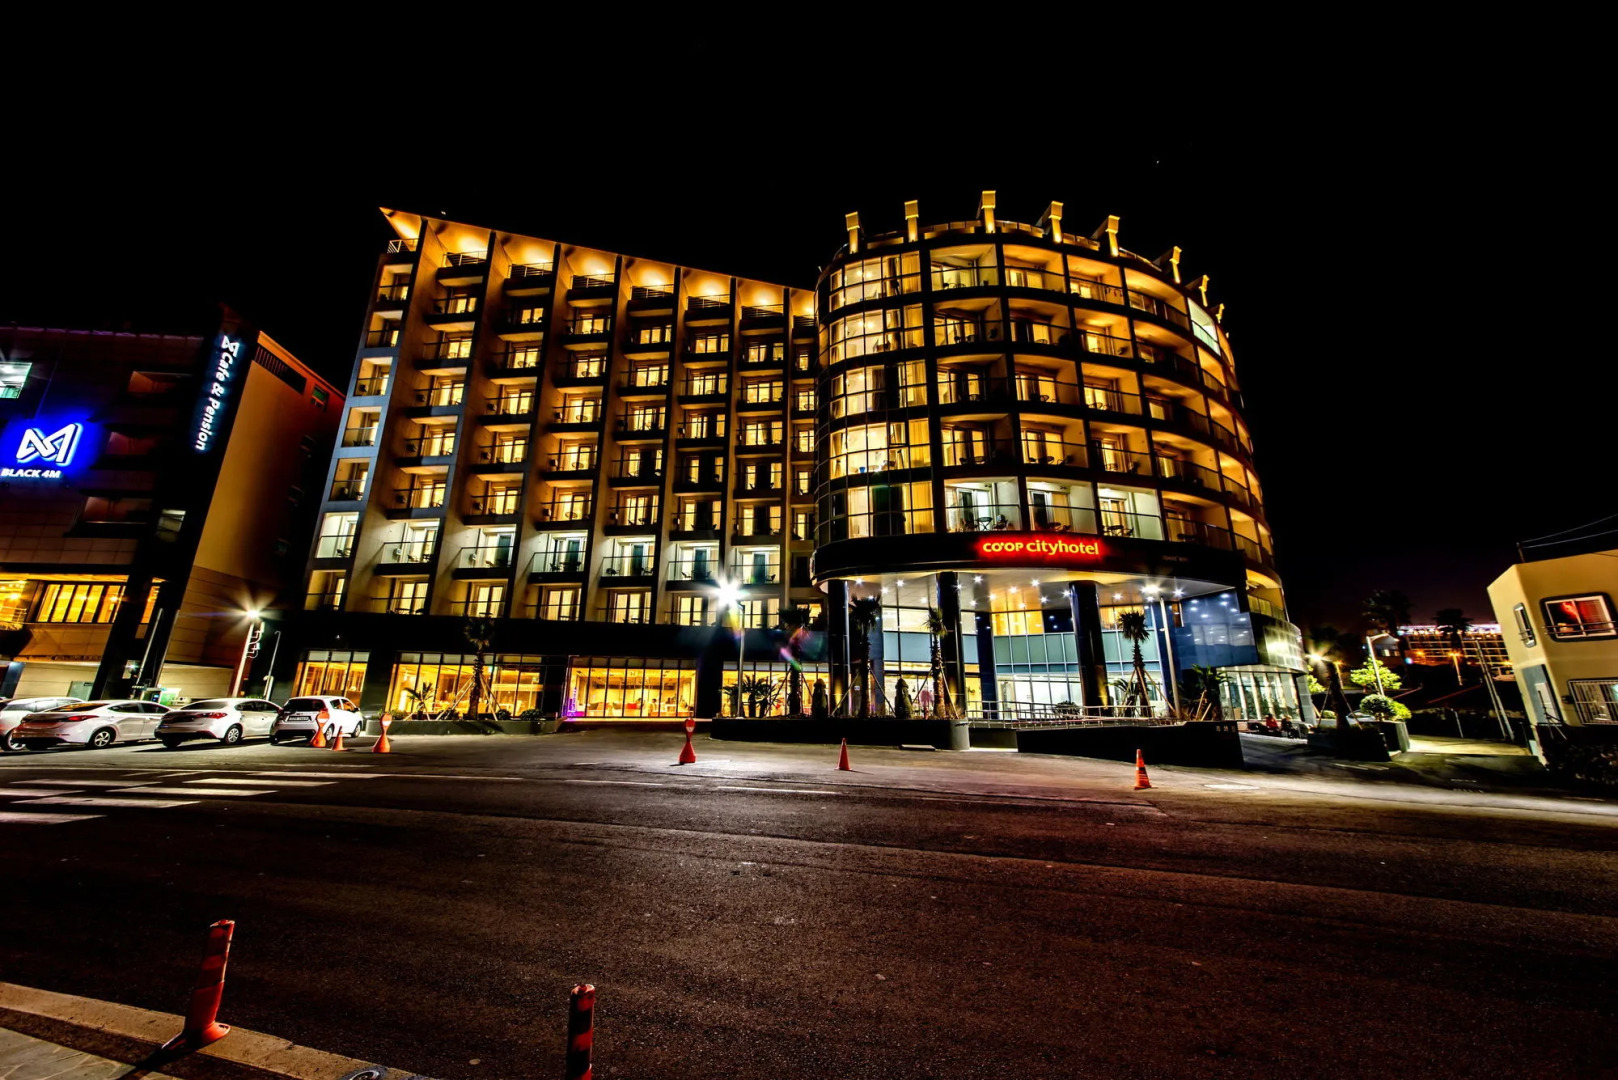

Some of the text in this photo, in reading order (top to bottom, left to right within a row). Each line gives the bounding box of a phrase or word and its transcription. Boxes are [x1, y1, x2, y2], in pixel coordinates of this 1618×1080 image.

[195, 352, 234, 451] Cafe & Pension
[0, 467, 61, 479] BLACK 4M
[1026, 539, 1099, 556] cityhotel
